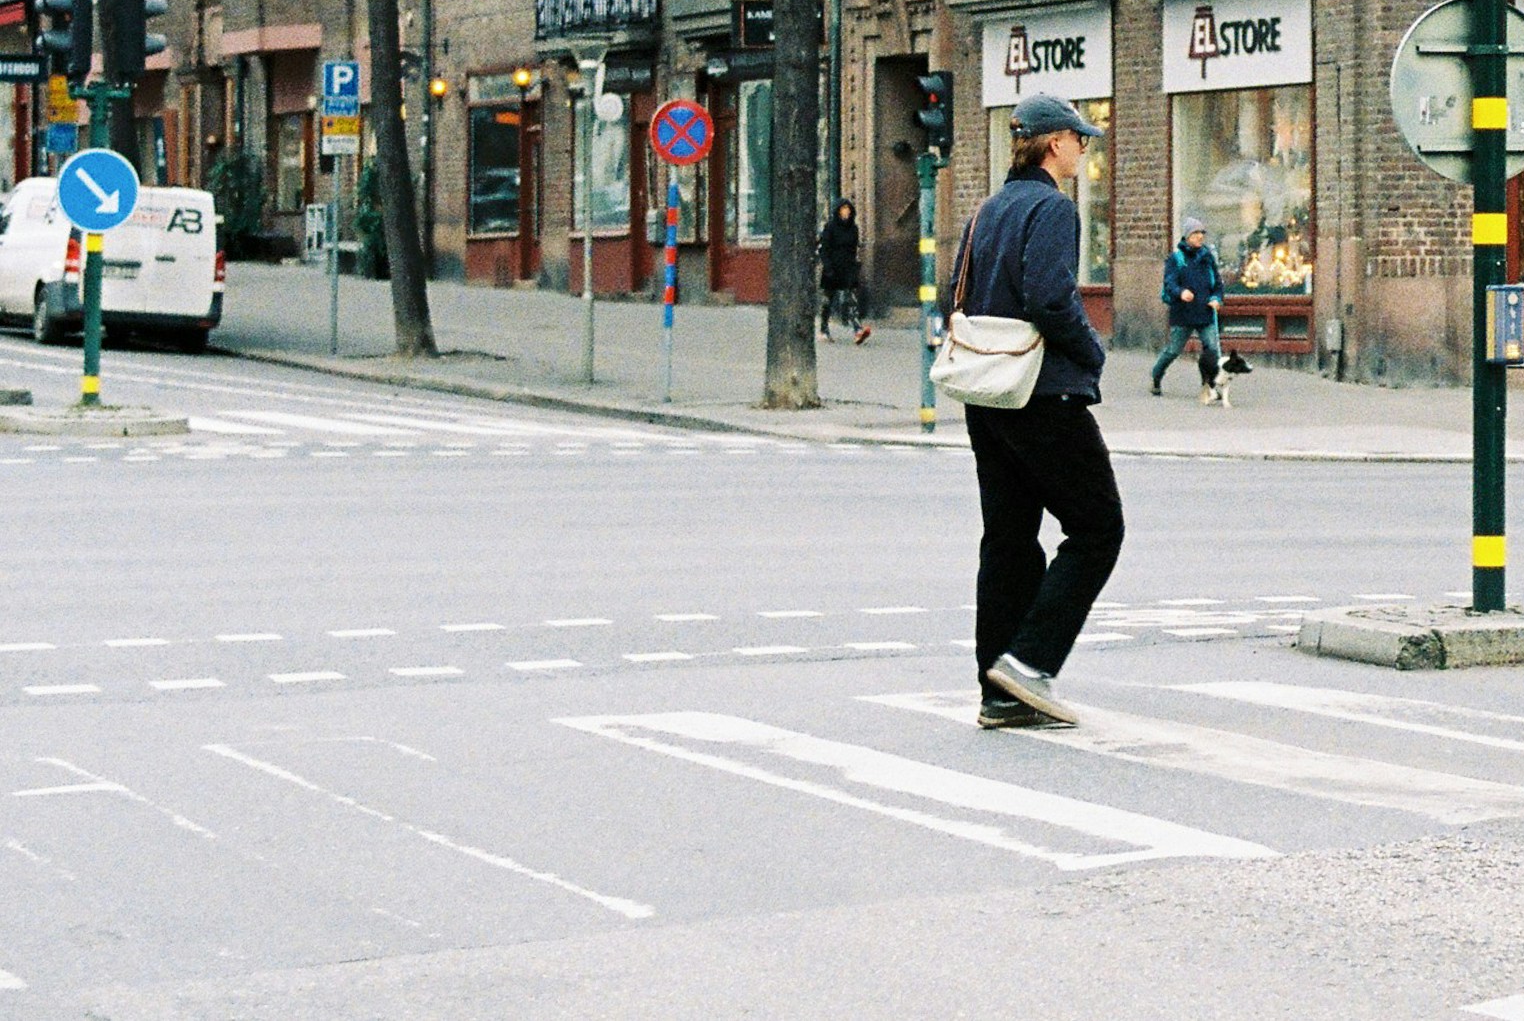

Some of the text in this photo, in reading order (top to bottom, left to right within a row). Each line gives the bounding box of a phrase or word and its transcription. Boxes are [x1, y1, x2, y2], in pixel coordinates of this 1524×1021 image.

[1009, 36, 1086, 73] EL STORE
[1194, 16, 1282, 56] EL STORE
[333, 65, 354, 93] P
